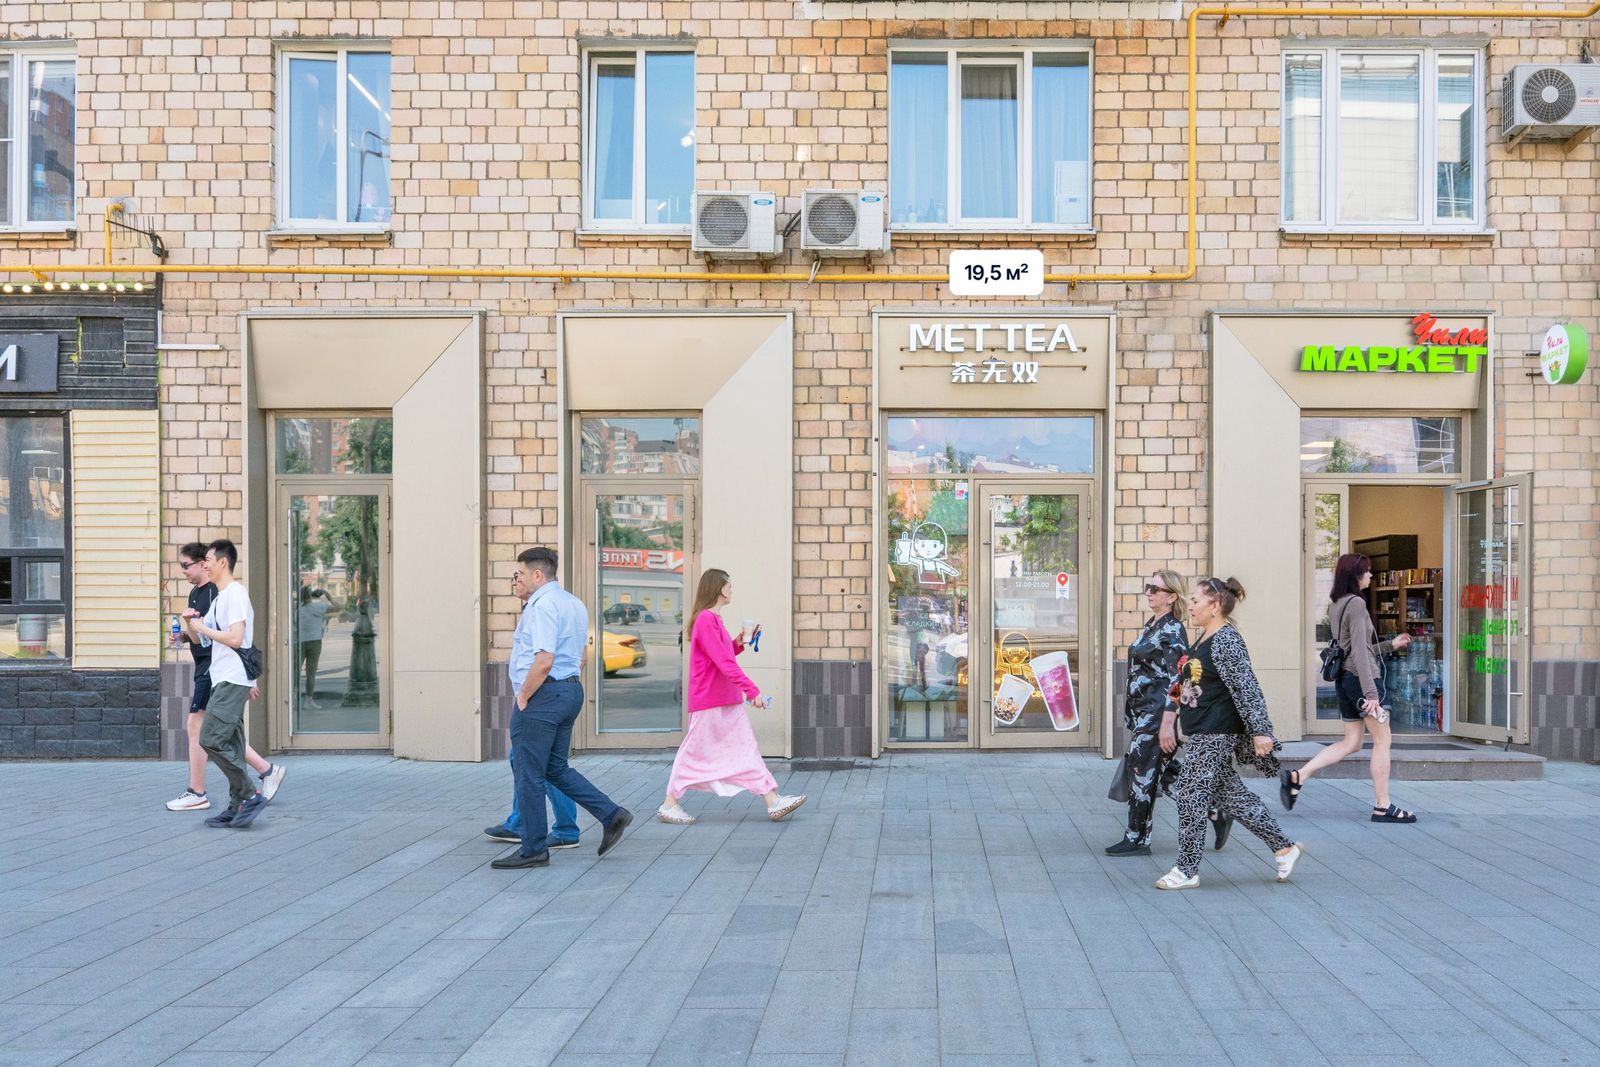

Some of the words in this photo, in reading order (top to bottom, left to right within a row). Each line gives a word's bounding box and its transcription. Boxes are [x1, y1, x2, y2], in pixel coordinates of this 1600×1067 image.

[908, 323, 991, 353] MET
[999, 323, 1078, 353] TEA
[1412, 312, 1488, 345] Чили
[951, 361, 1038, 383] 茶无双
[1301, 345, 1488, 373] МАРКЕТ
